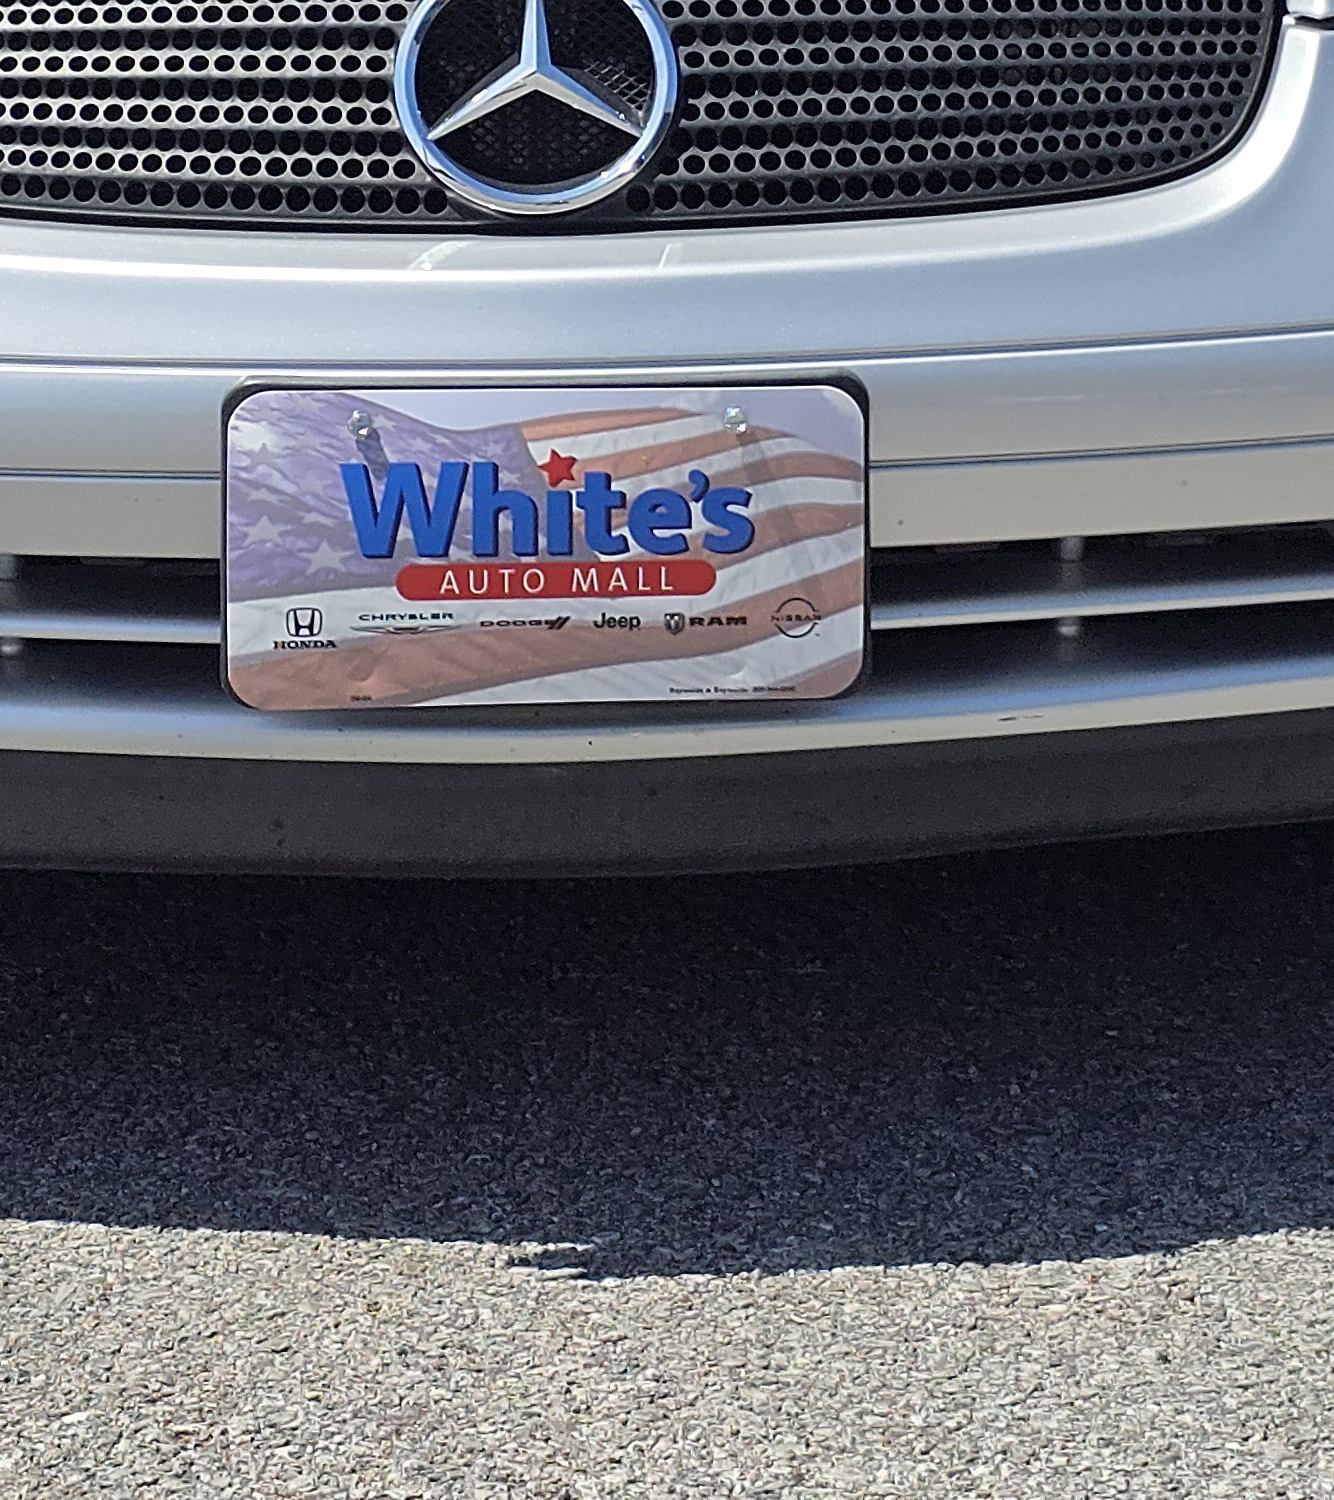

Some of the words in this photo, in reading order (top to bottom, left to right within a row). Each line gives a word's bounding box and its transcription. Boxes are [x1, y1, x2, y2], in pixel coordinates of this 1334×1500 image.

[339, 451, 755, 558] White's
[439, 567, 546, 595] AUTO
[570, 565, 674, 592] MALL
[358, 612, 455, 621] CHRYSLER
[592, 612, 642, 631] Jeep
[689, 615, 748, 627] RAM
[770, 613, 822, 622] NISSAN
[479, 618, 559, 629] DODGE
[273, 639, 338, 650] HONDA
